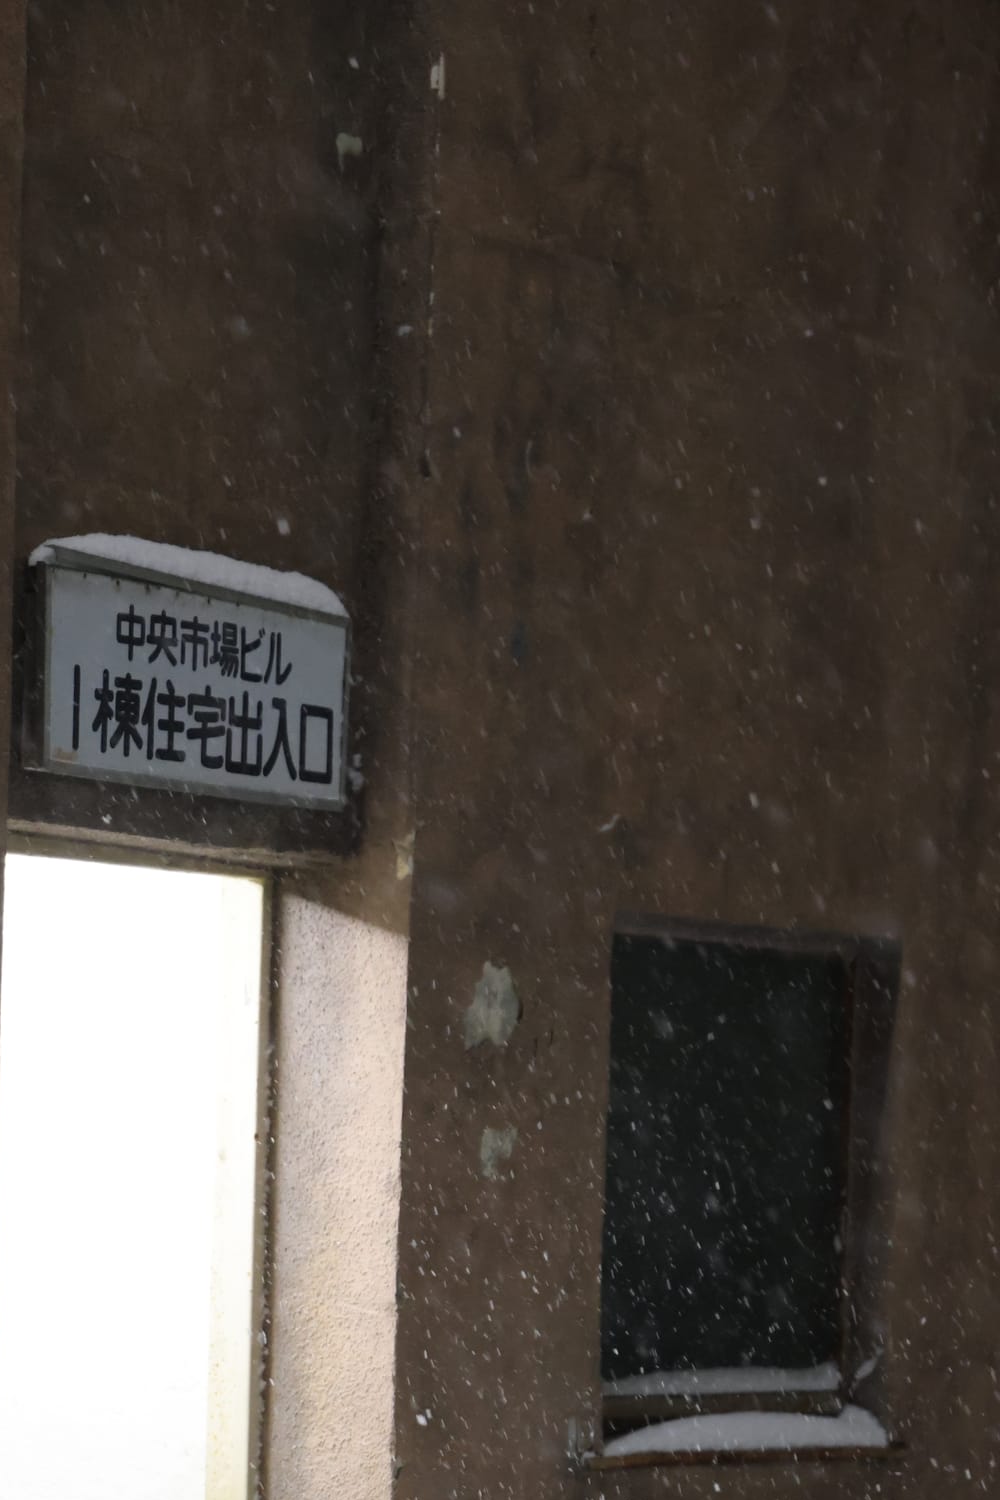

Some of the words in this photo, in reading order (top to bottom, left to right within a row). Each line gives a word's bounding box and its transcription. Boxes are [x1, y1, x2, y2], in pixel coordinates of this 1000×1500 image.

[115, 604, 292, 685] 中央市場ビル
